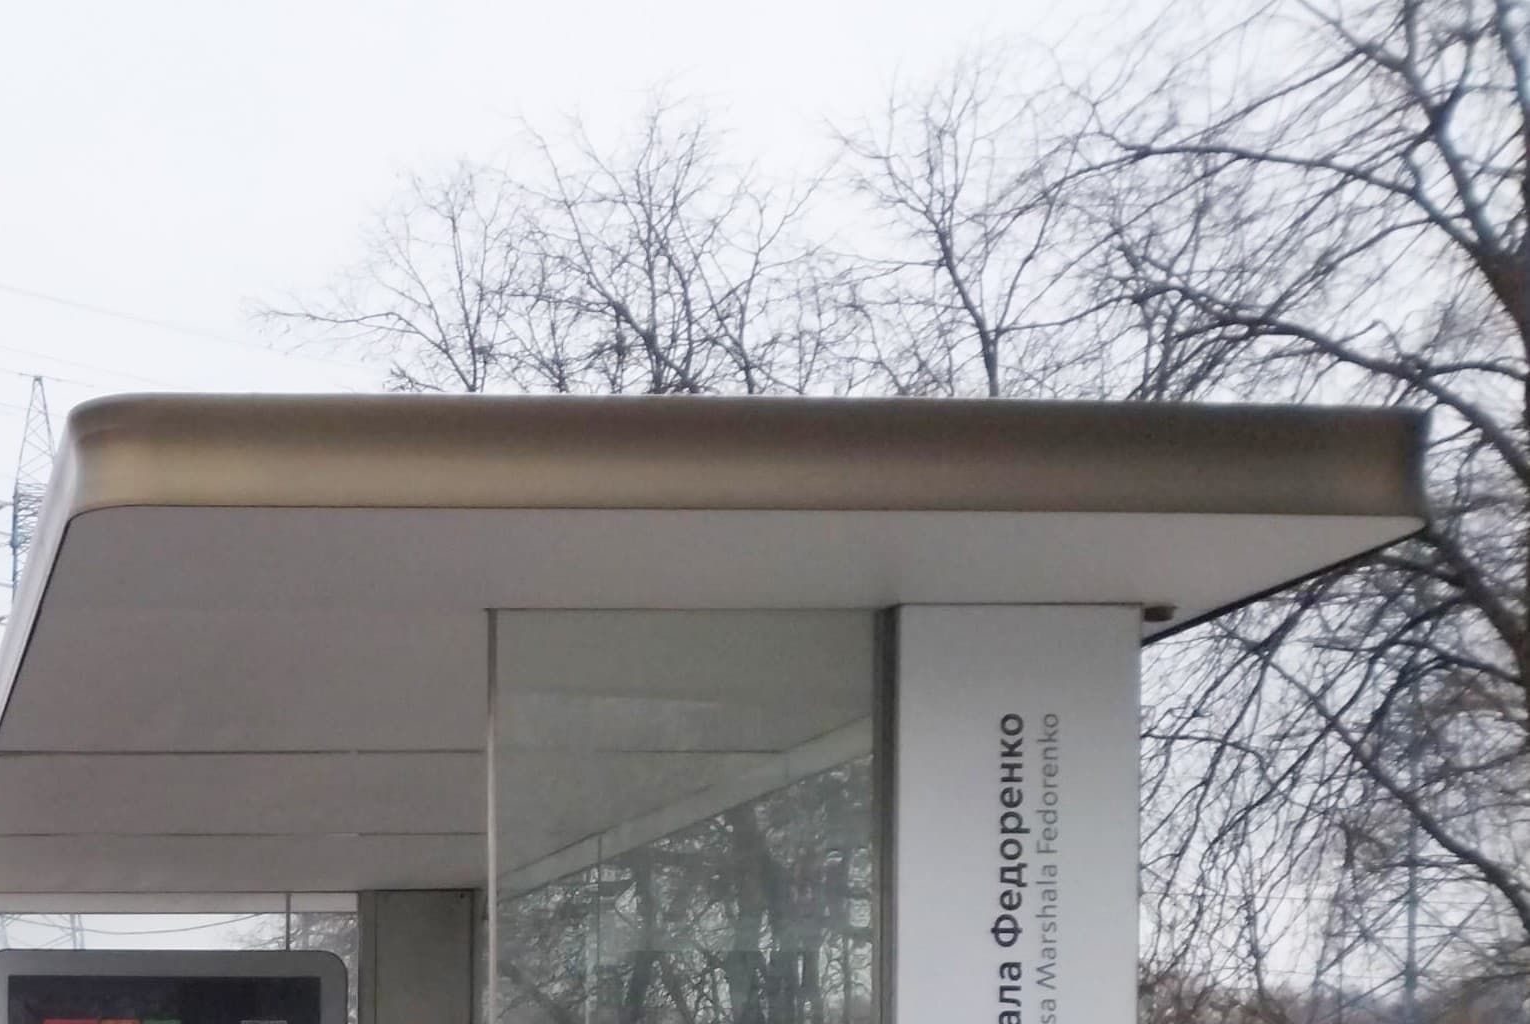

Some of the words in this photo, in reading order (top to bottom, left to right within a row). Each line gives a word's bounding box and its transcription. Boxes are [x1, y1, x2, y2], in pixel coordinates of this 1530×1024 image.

[990, 712, 1030, 949] Федоренко
[1035, 712, 1060, 854] Fedorenko
[1035, 862, 1058, 990] Marshala
